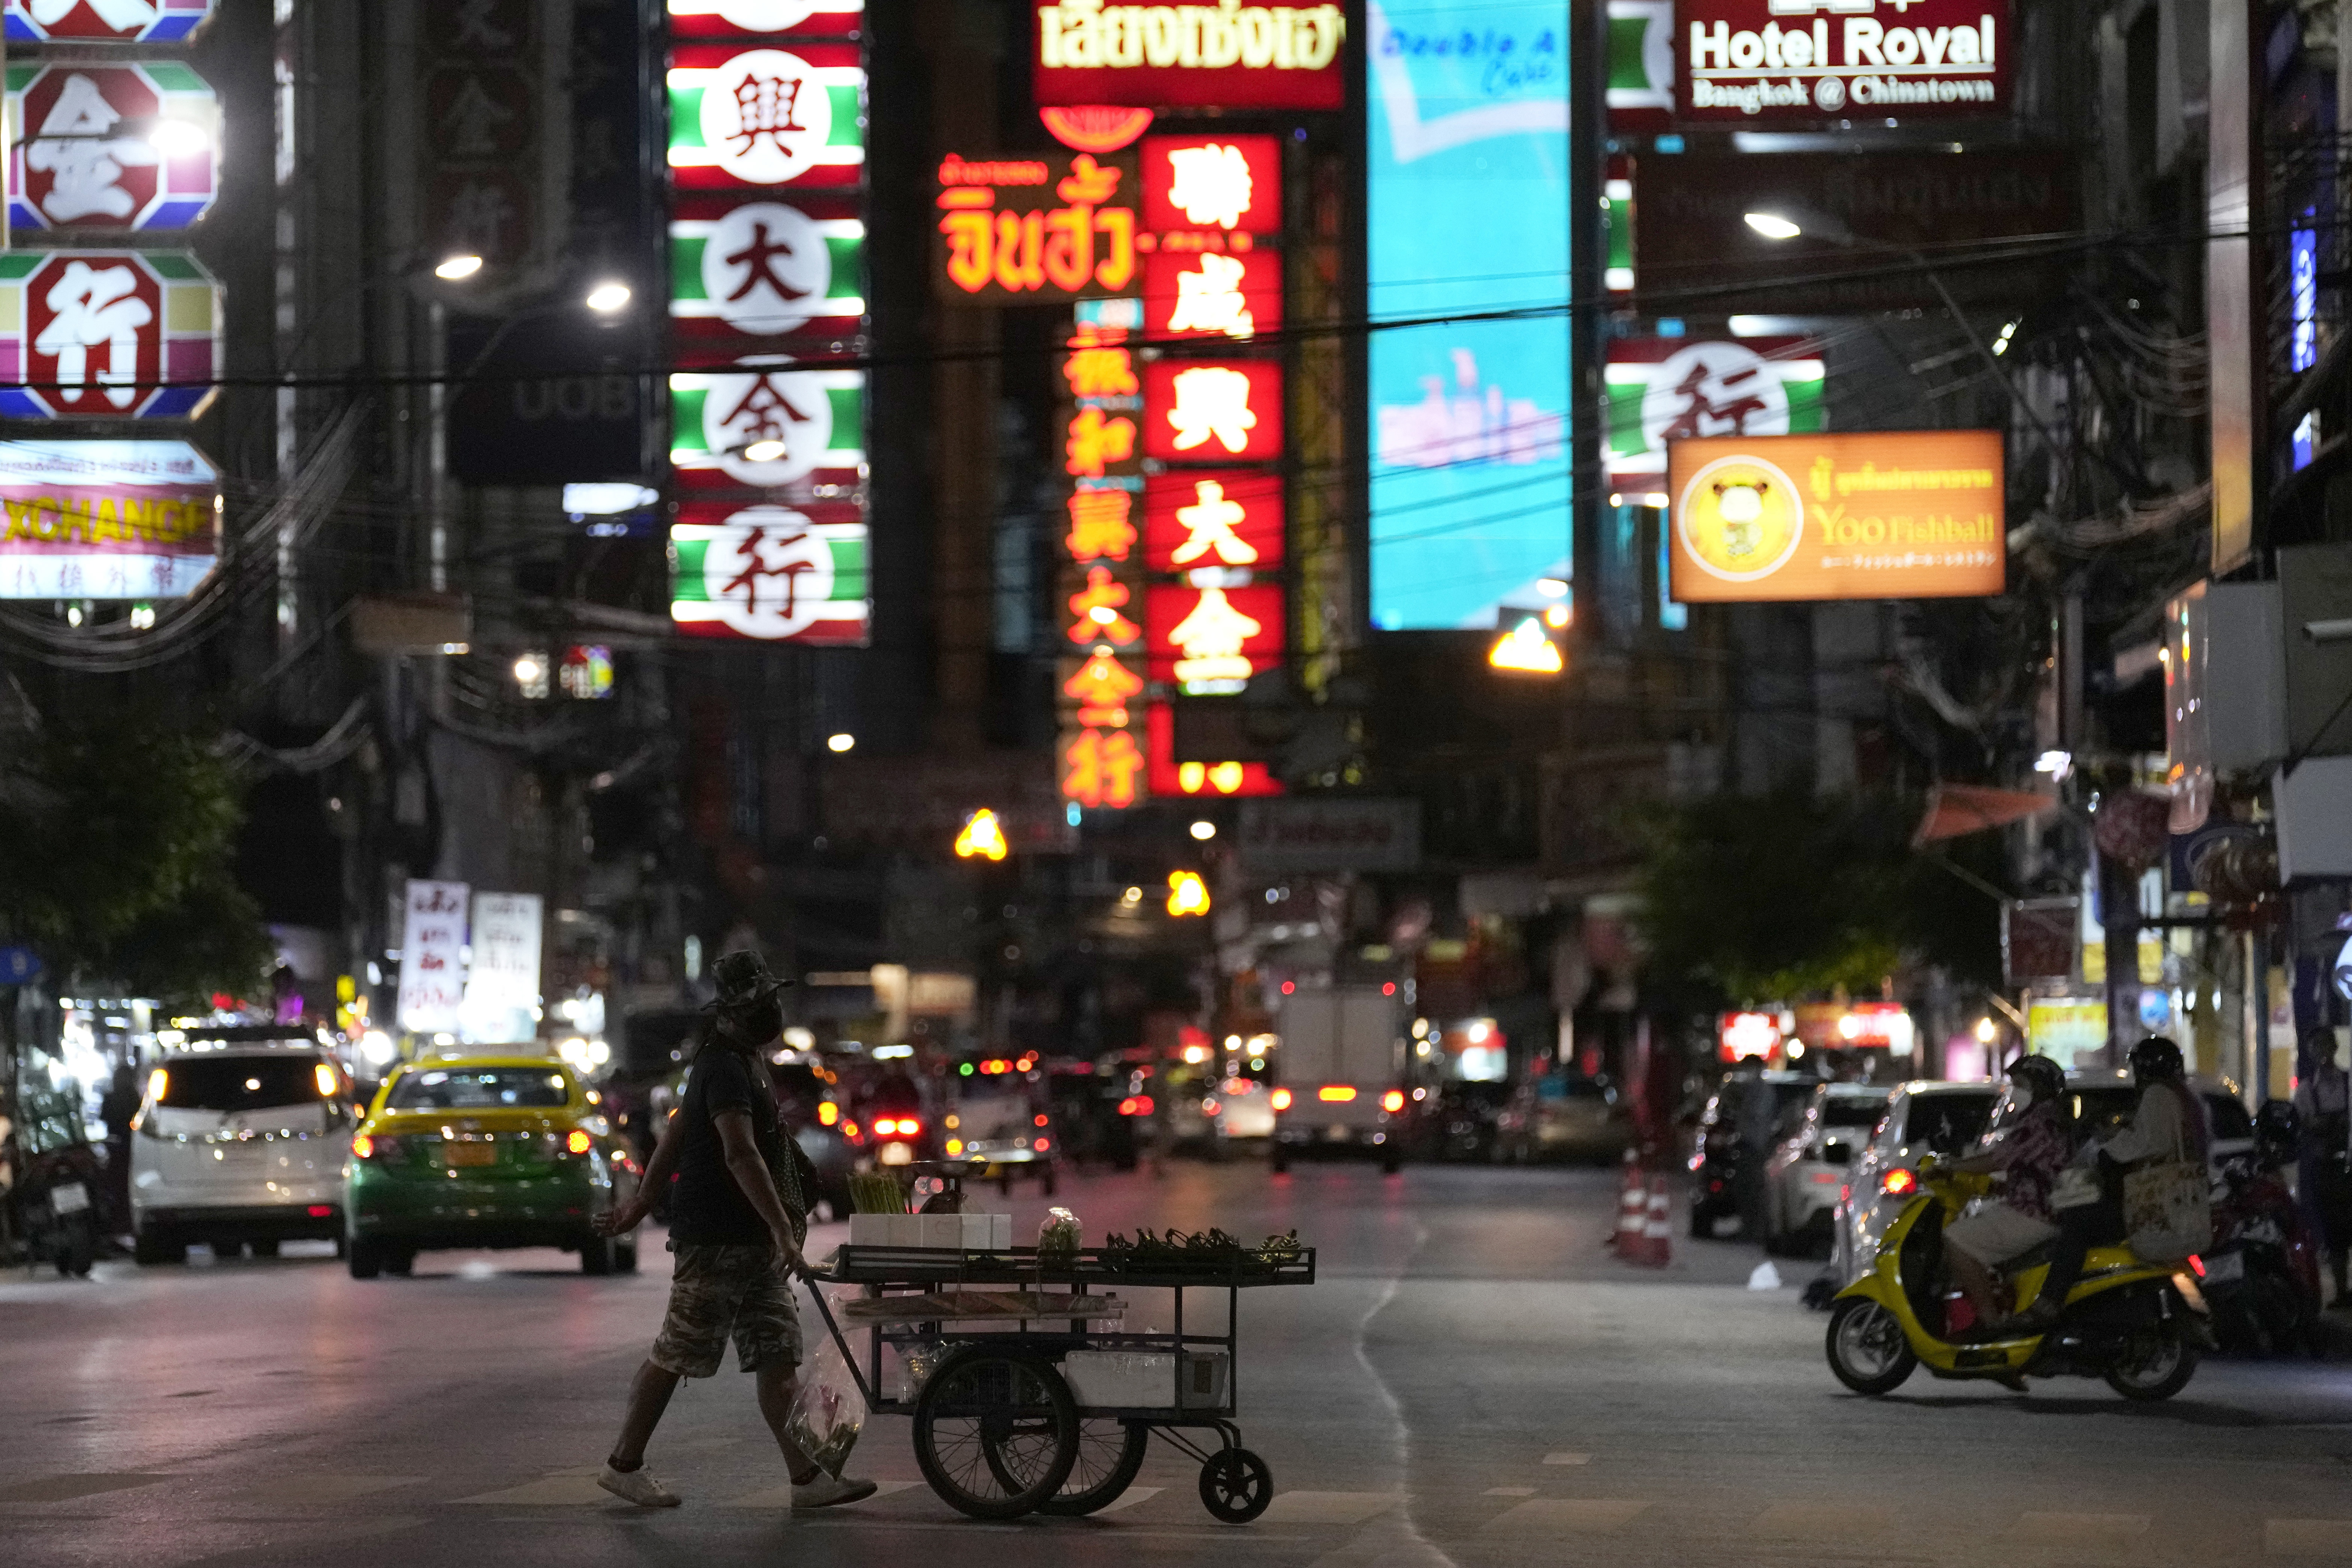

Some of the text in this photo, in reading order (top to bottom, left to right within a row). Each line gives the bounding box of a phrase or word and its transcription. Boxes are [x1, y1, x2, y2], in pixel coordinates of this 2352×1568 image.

[1690, 14, 1995, 69] Hotel Royal
[1693, 75, 1995, 114] Bangkok @ Chinatown
[1890, 513, 1995, 544] Fishball
